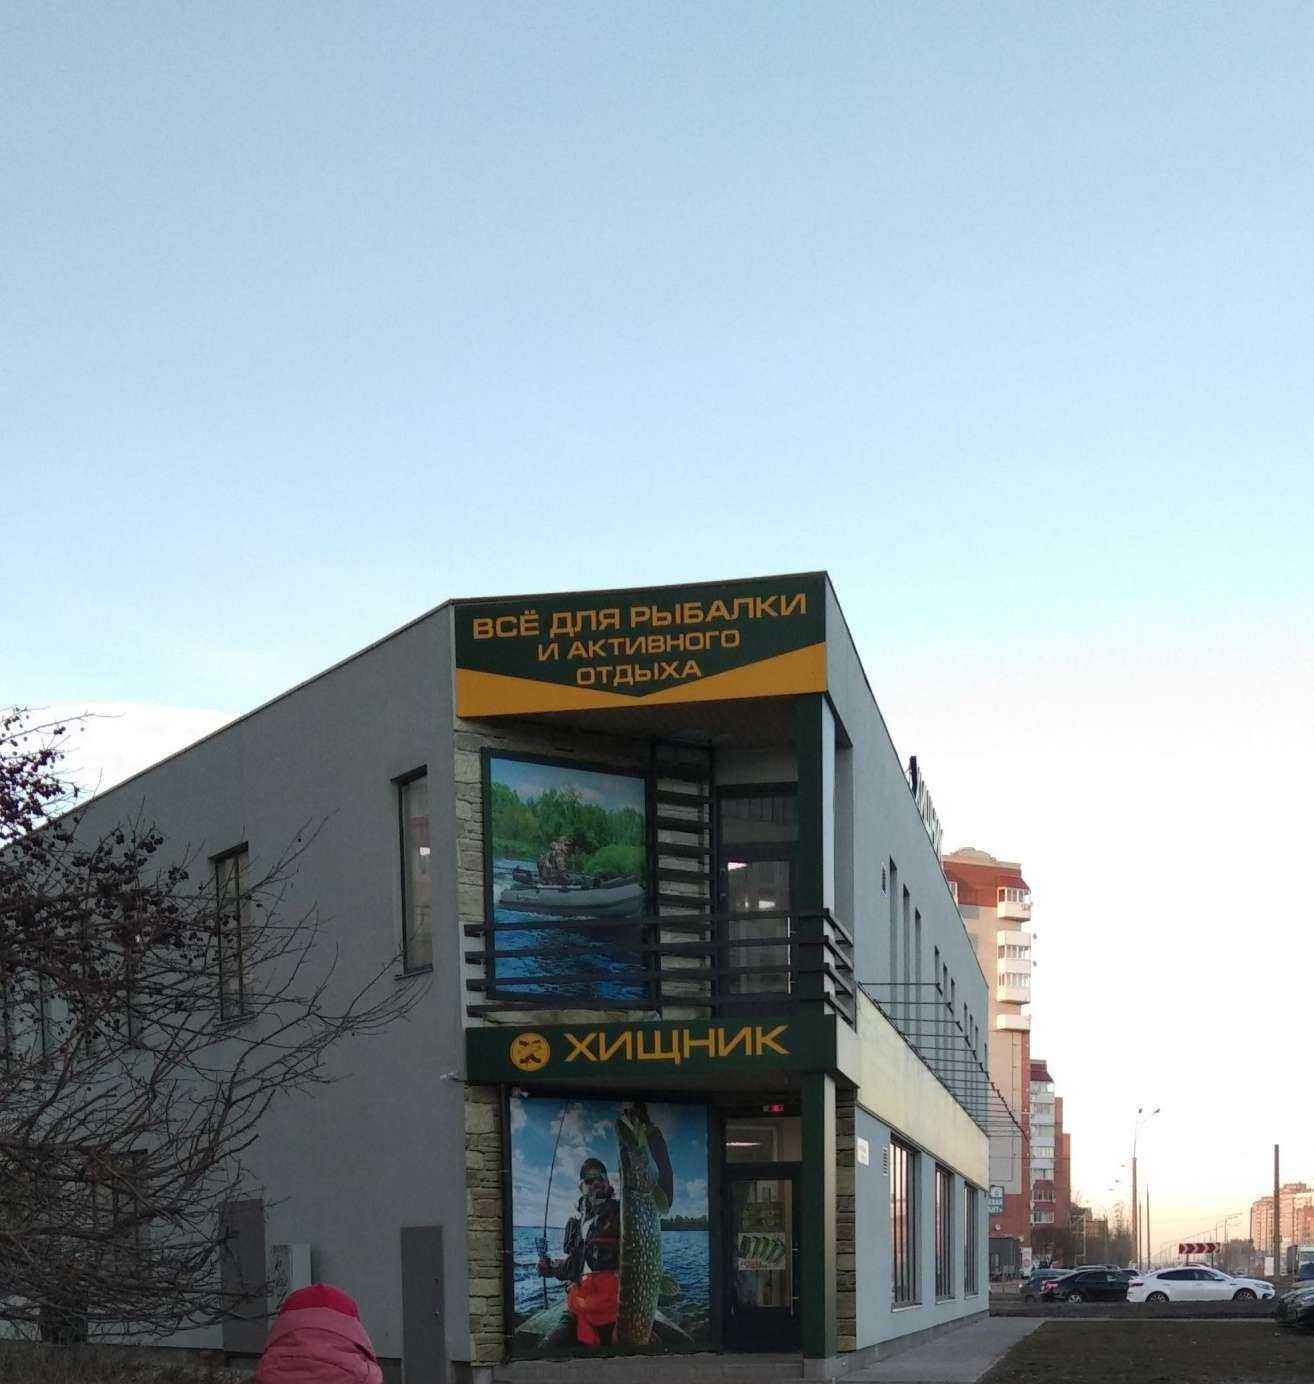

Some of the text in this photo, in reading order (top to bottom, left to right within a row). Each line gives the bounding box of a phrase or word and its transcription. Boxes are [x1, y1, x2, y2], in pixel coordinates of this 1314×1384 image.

[473, 592, 807, 640] ВСЁ ДЛЯ РЫБАЛКИ
[538, 629, 740, 661] И АКТИВНОГО
[576, 659, 702, 687] ОТДЫХА
[563, 1024, 791, 1065] ХИЩНИК
